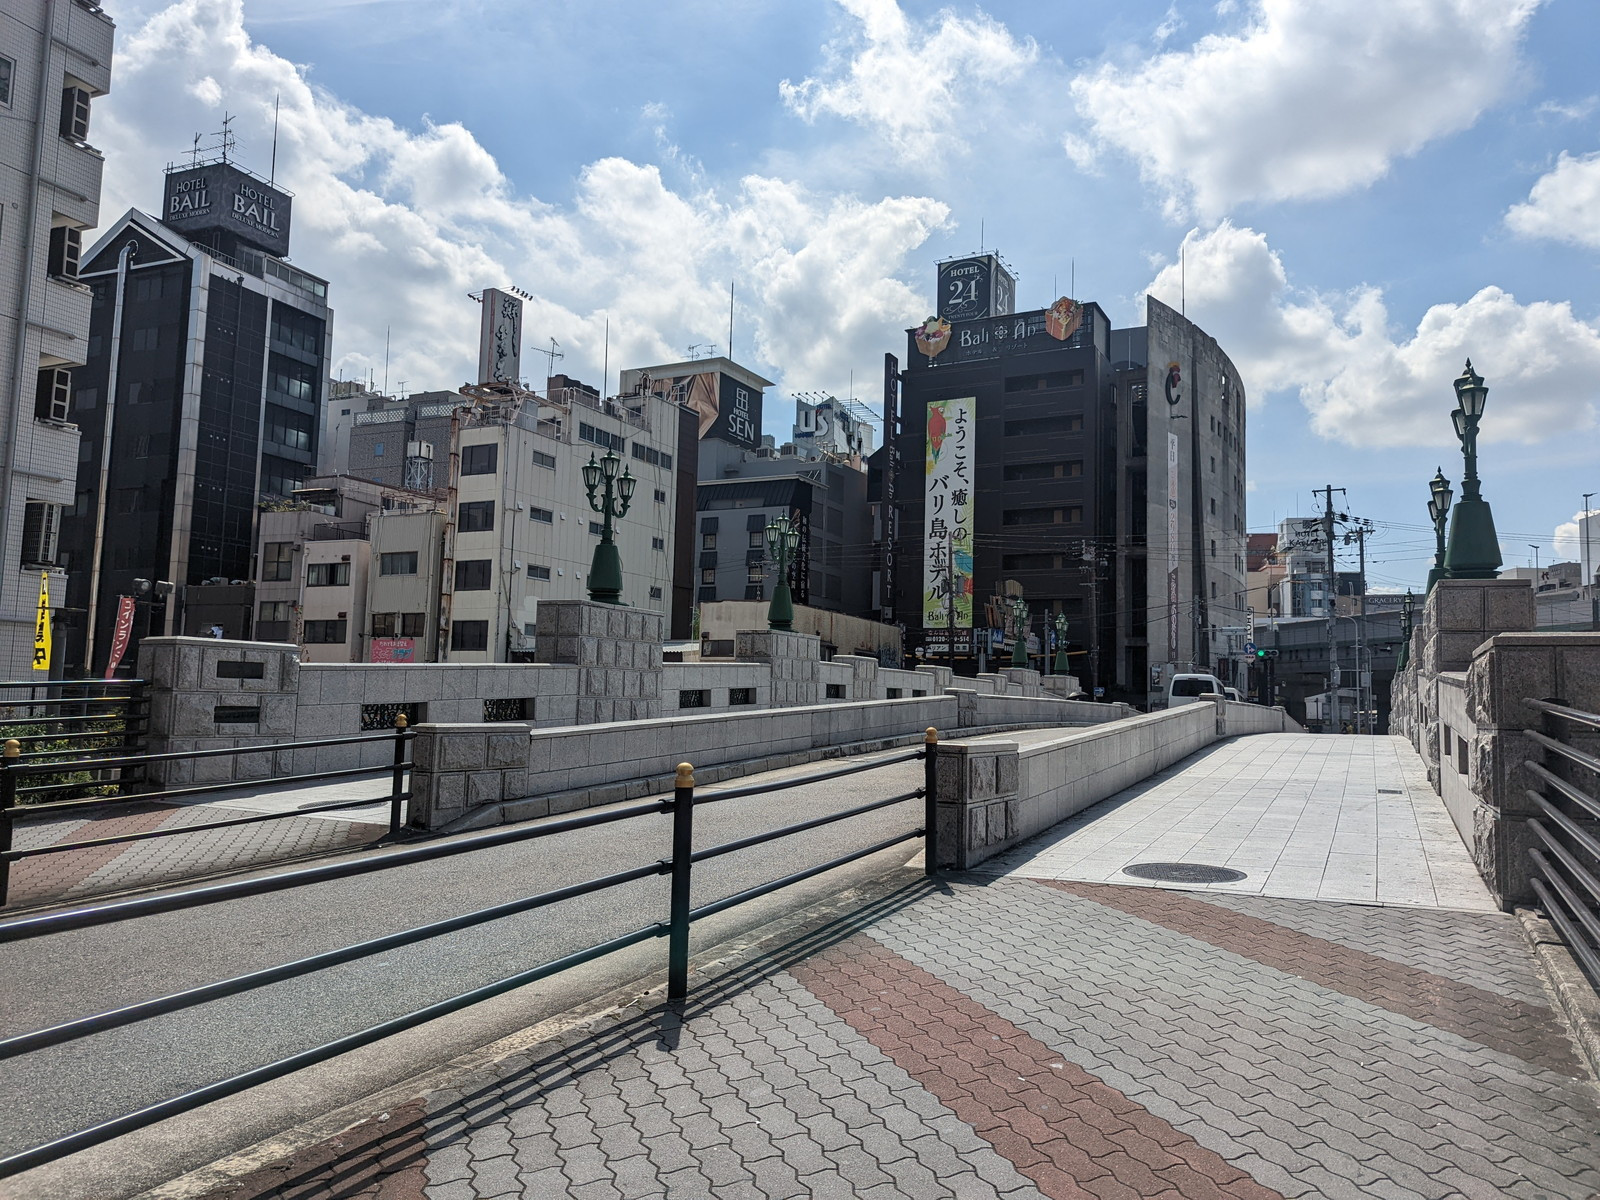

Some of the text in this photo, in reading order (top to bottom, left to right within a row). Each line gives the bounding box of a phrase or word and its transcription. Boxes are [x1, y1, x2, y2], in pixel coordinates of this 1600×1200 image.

[176, 178, 206, 193] HOTEL
[241, 184, 275, 210] HOTEL
[170, 190, 210, 214] BAIL
[233, 193, 280, 231] BAIL
[231, 212, 255, 228] DELUXE
[950, 266, 980, 277] HOTEL
[948, 279, 980, 305] 24
[960, 321, 1037, 347] Bali An
[733, 407, 750, 421] HOTEL
[728, 414, 754, 441] SEN
[951, 408, 969, 541] ようこそ、癒しの
[886, 504, 895, 599] RESORT
[927, 611, 944, 621] Bali
